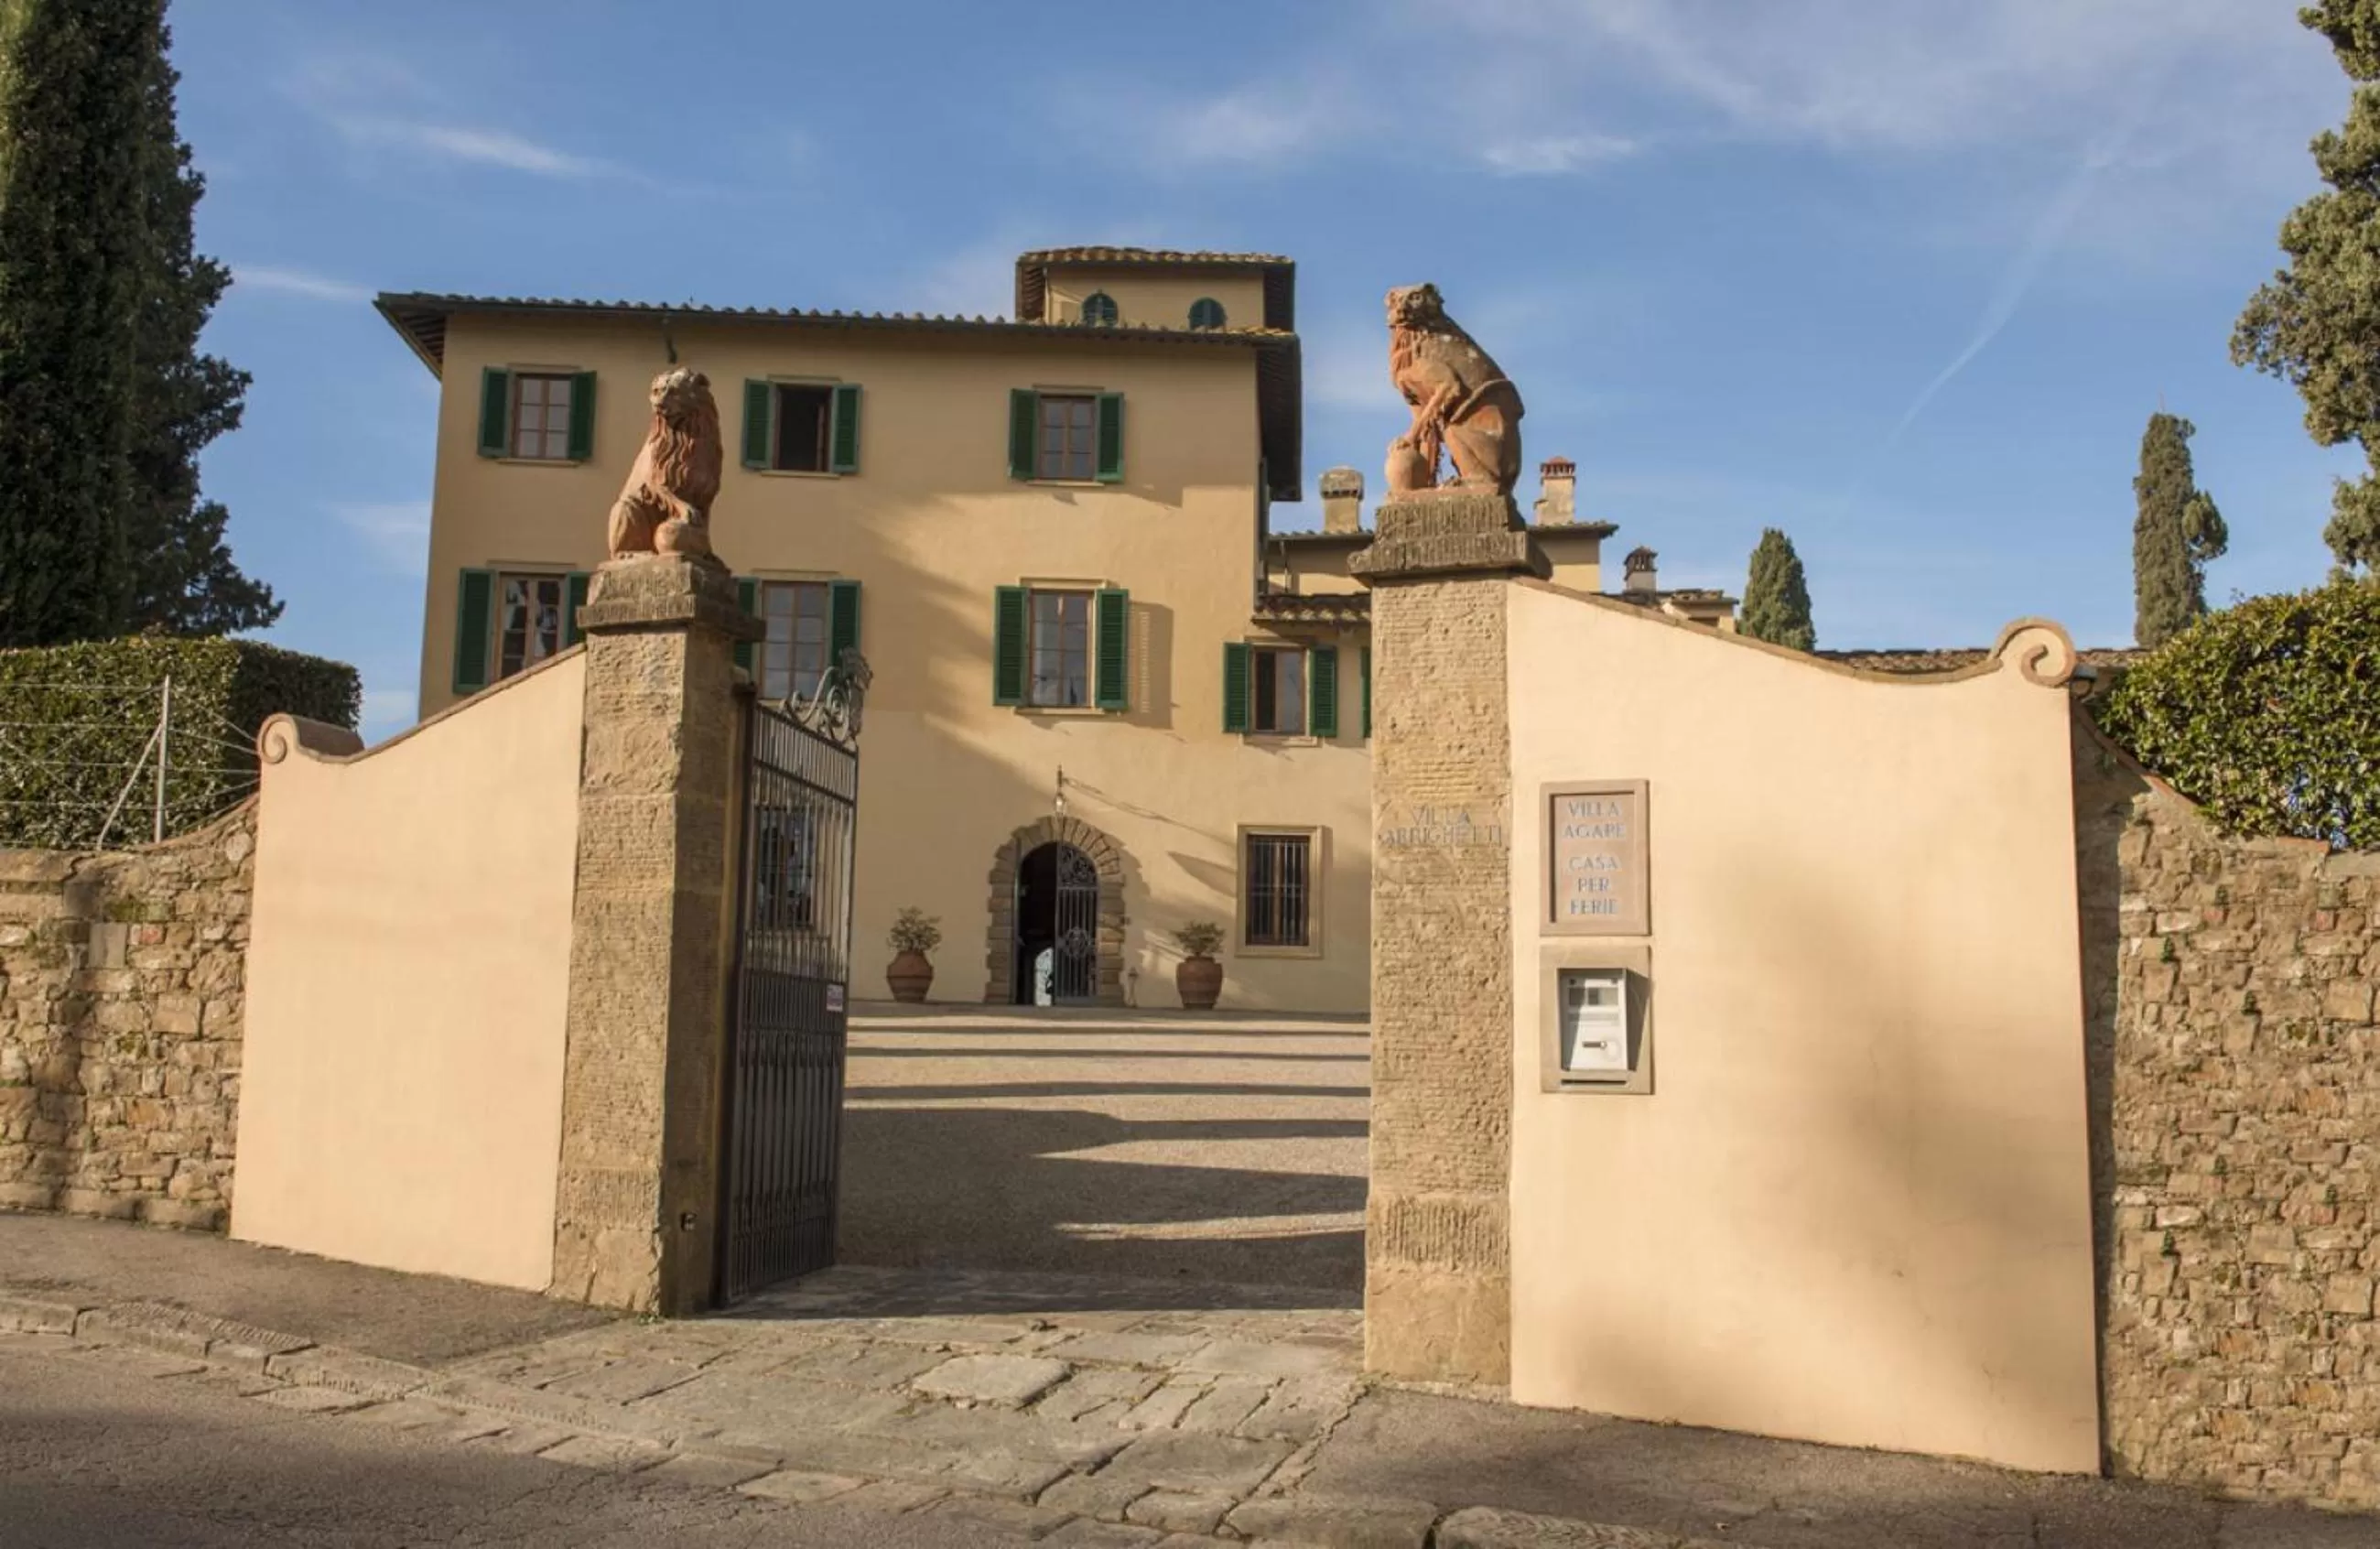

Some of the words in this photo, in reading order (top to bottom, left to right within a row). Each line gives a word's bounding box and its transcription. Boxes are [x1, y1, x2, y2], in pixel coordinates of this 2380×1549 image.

[1568, 801, 1619, 818] VILLA
[1563, 824, 1625, 839] AGAPE
[1569, 855, 1618, 870] CASA
[1578, 877, 1609, 893] PER
[1570, 898, 1618, 915] FERIE
